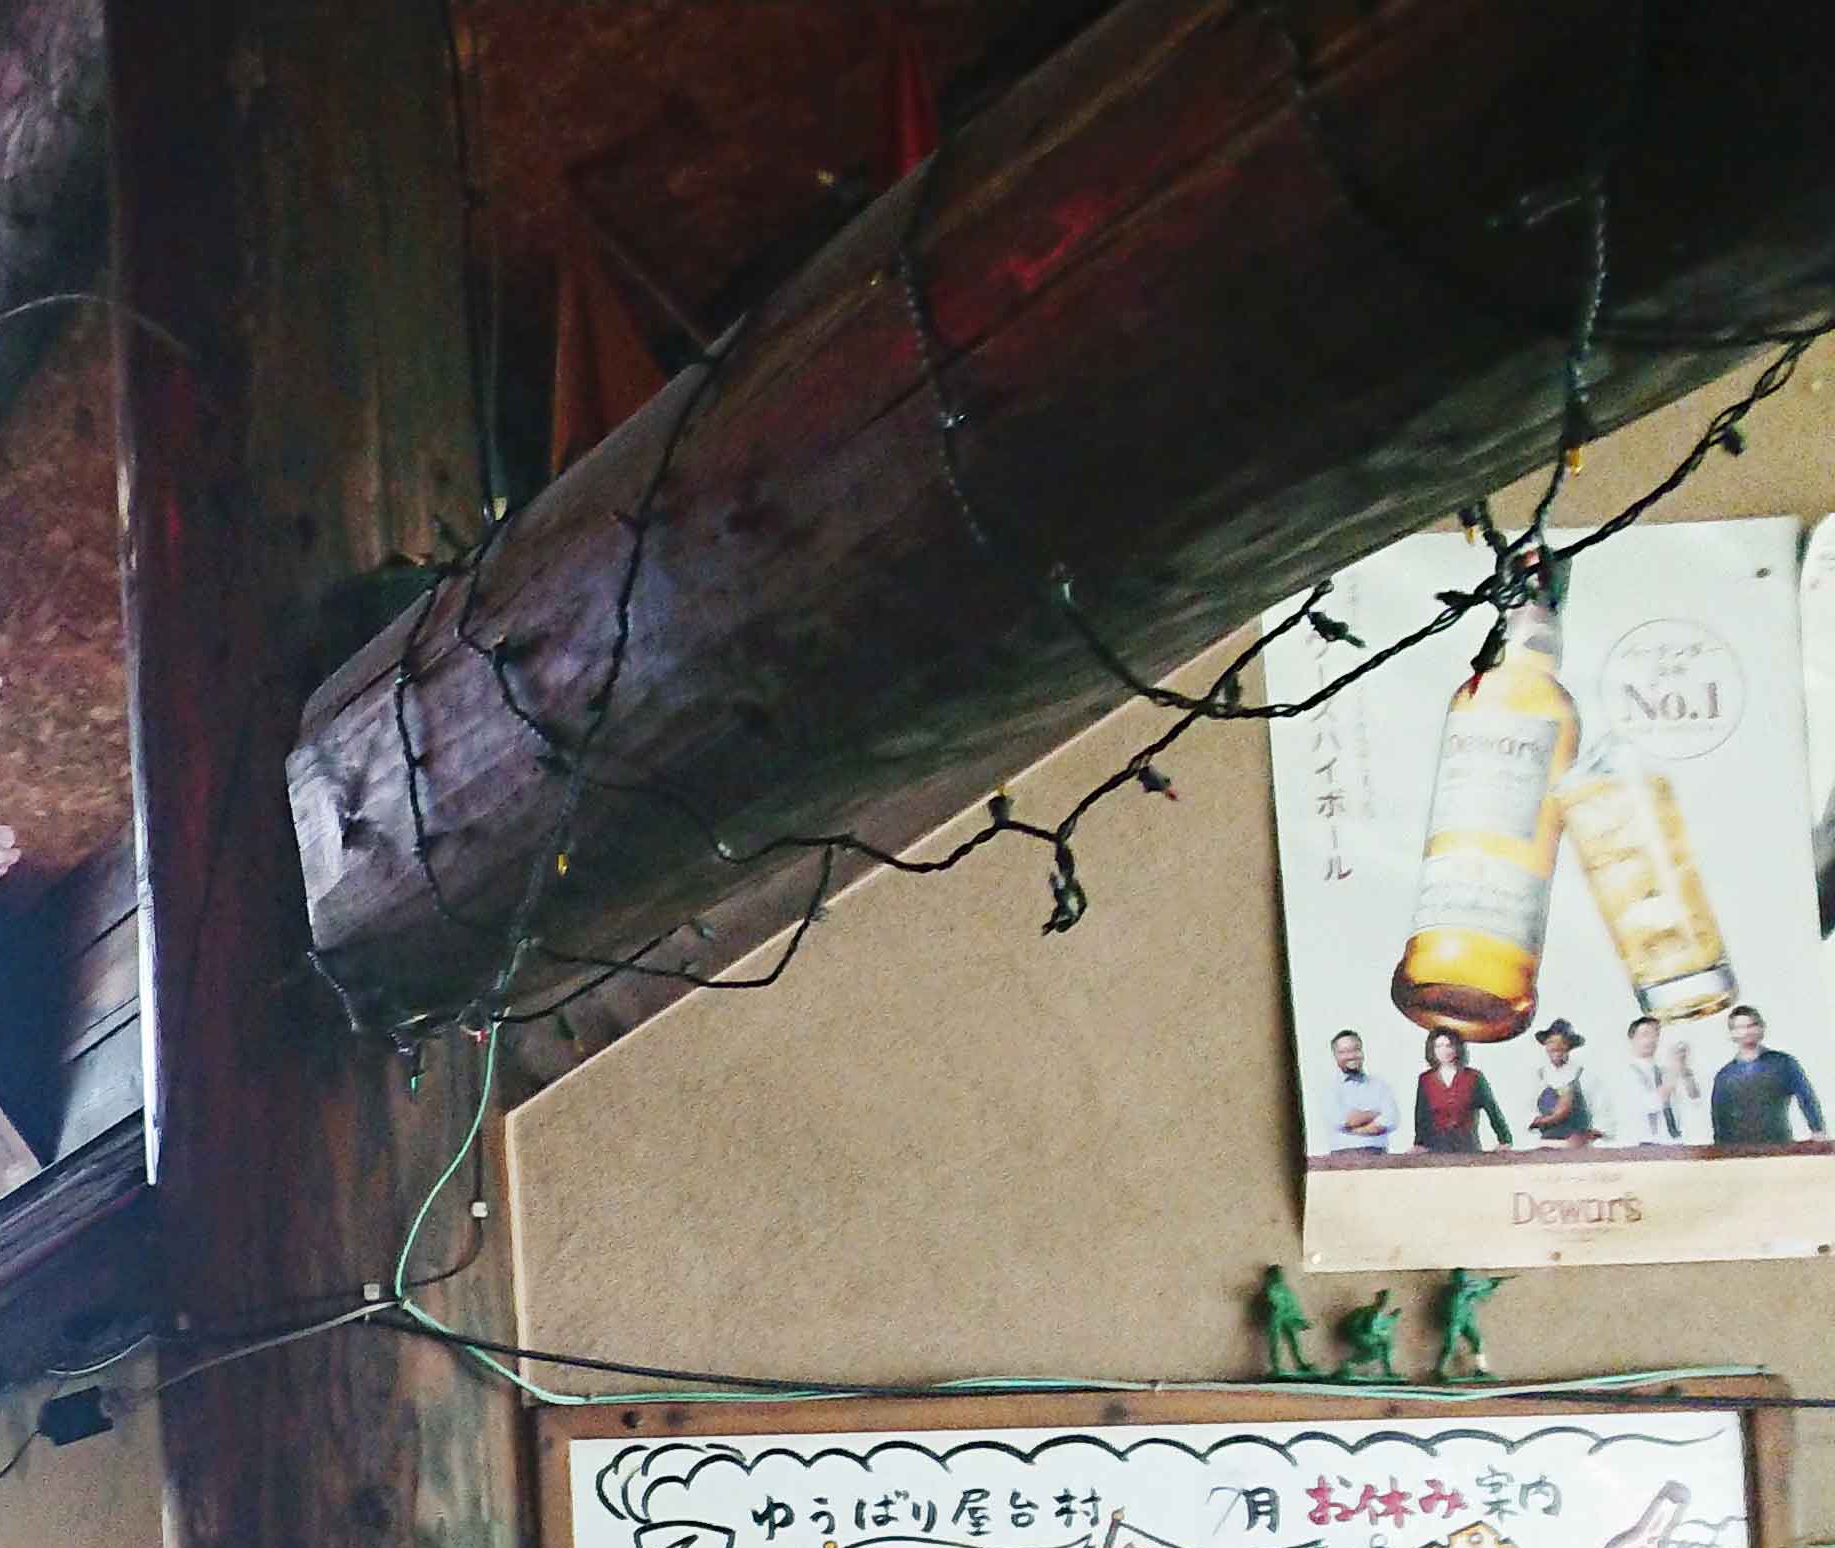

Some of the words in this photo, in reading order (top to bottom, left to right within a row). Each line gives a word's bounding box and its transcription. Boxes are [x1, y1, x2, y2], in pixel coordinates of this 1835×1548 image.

[1622, 681, 1724, 721] No.1
[752, 1488, 1103, 1540] ゆうばり屋台村
